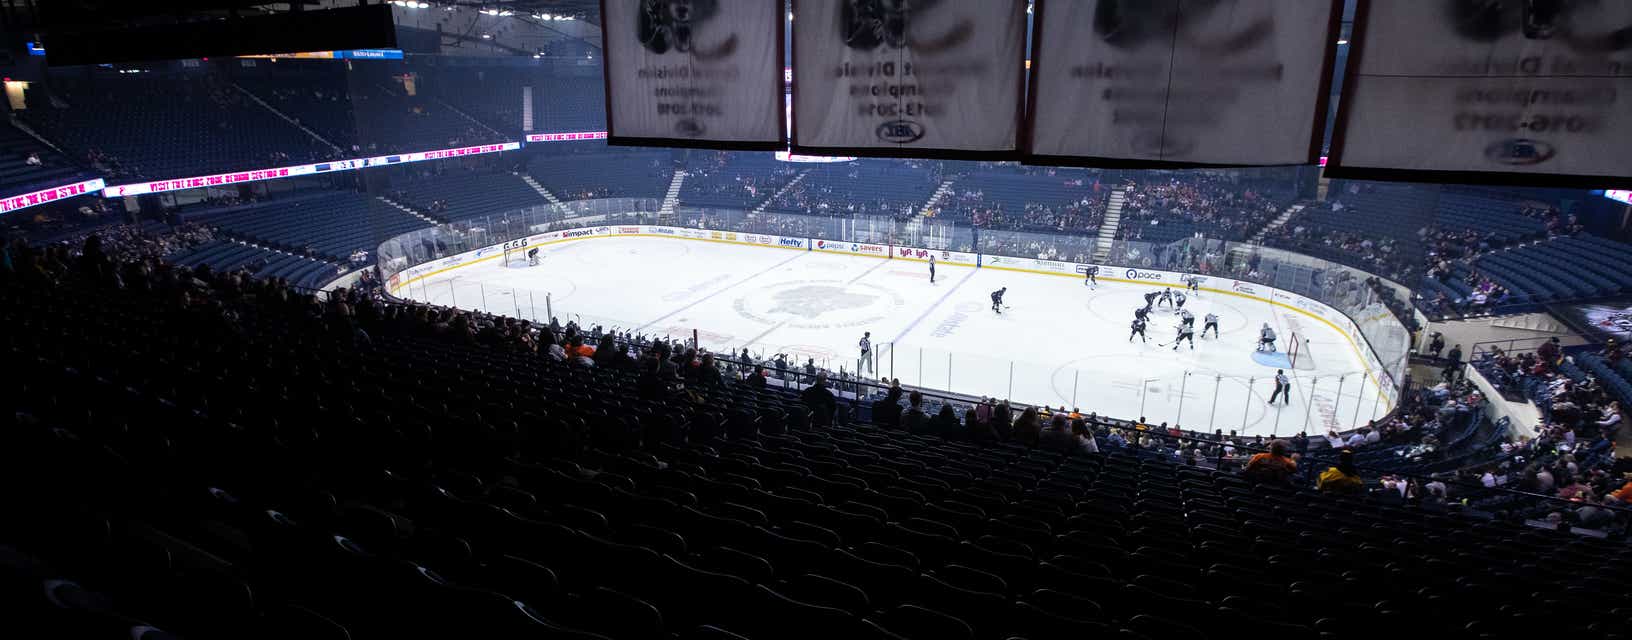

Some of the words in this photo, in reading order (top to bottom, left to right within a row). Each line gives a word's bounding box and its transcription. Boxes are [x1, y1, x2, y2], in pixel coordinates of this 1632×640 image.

[149, 181, 170, 192] VISIT
[567, 229, 593, 238] impact
[780, 238, 802, 248] Hefty
[900, 248, 913, 257] lyft
[916, 249, 929, 258] lyft
[1137, 271, 1162, 280] pace
